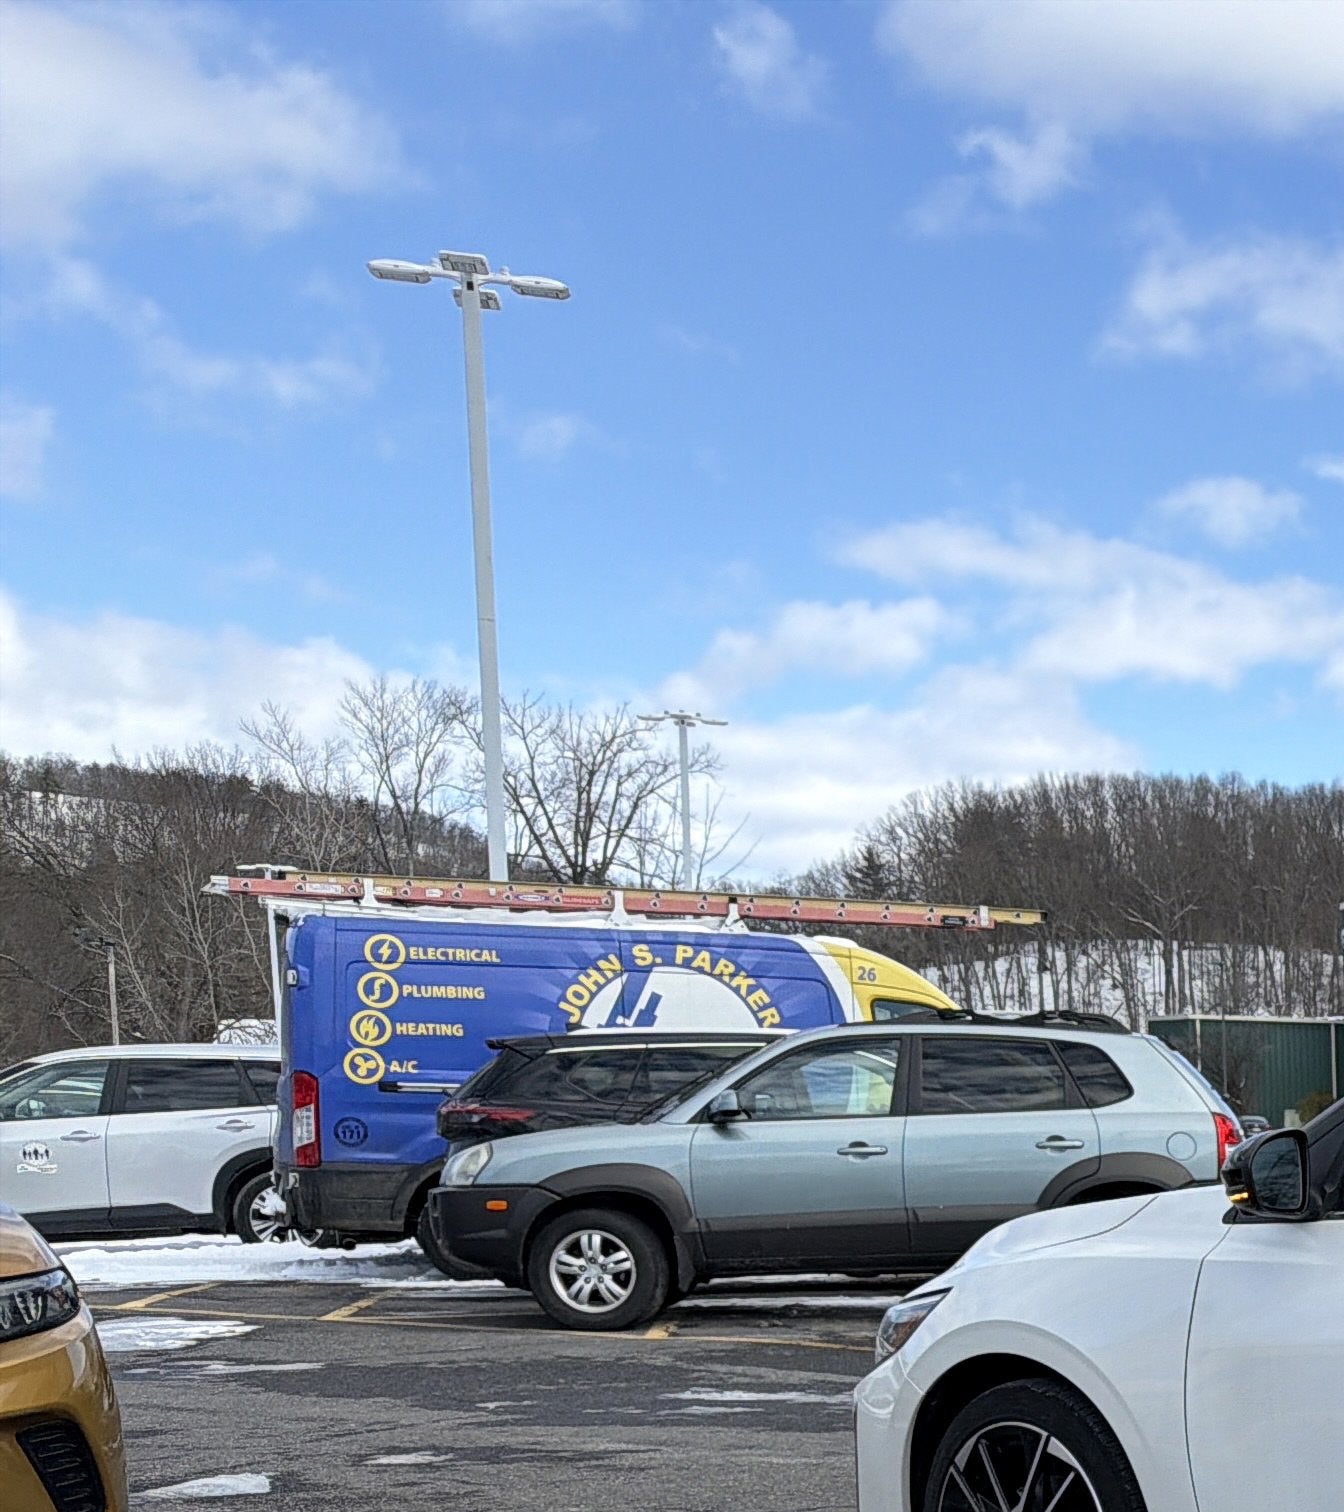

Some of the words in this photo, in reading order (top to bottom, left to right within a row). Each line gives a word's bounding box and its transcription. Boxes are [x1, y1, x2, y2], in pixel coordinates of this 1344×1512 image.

[409, 946, 501, 963] ELECTRICAL
[857, 966, 876, 983] 26
[402, 984, 486, 1000] PLUMBING
[558, 953, 623, 1024] JOHN
[631, 943, 662, 967] S.
[675, 943, 782, 1028] PARKER
[395, 1022, 464, 1037] HEATING
[389, 1060, 419, 1074] A/C
